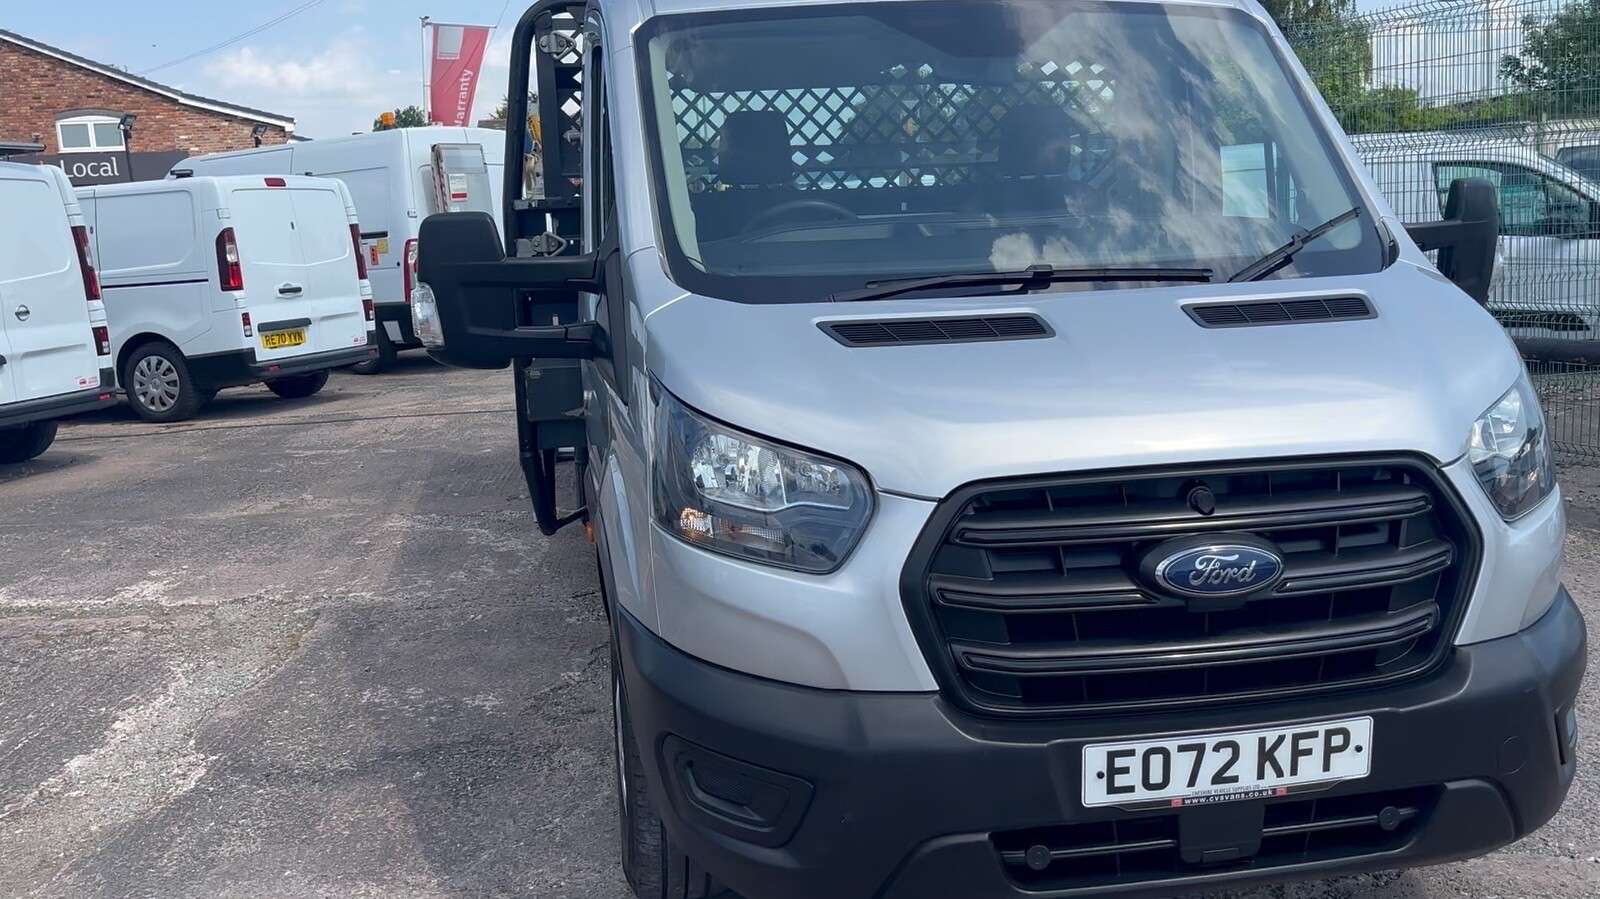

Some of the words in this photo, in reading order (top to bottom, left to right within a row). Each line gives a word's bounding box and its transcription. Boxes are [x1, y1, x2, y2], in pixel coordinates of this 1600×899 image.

[60, 156, 120, 178] Local
[264, 333, 287, 346] RE70
[1189, 554, 1257, 586] Ford
[1106, 739, 1241, 796] EO72
[1256, 727, 1351, 781] KFP
[1184, 790, 1273, 805] www.cvsvans.co.uk
